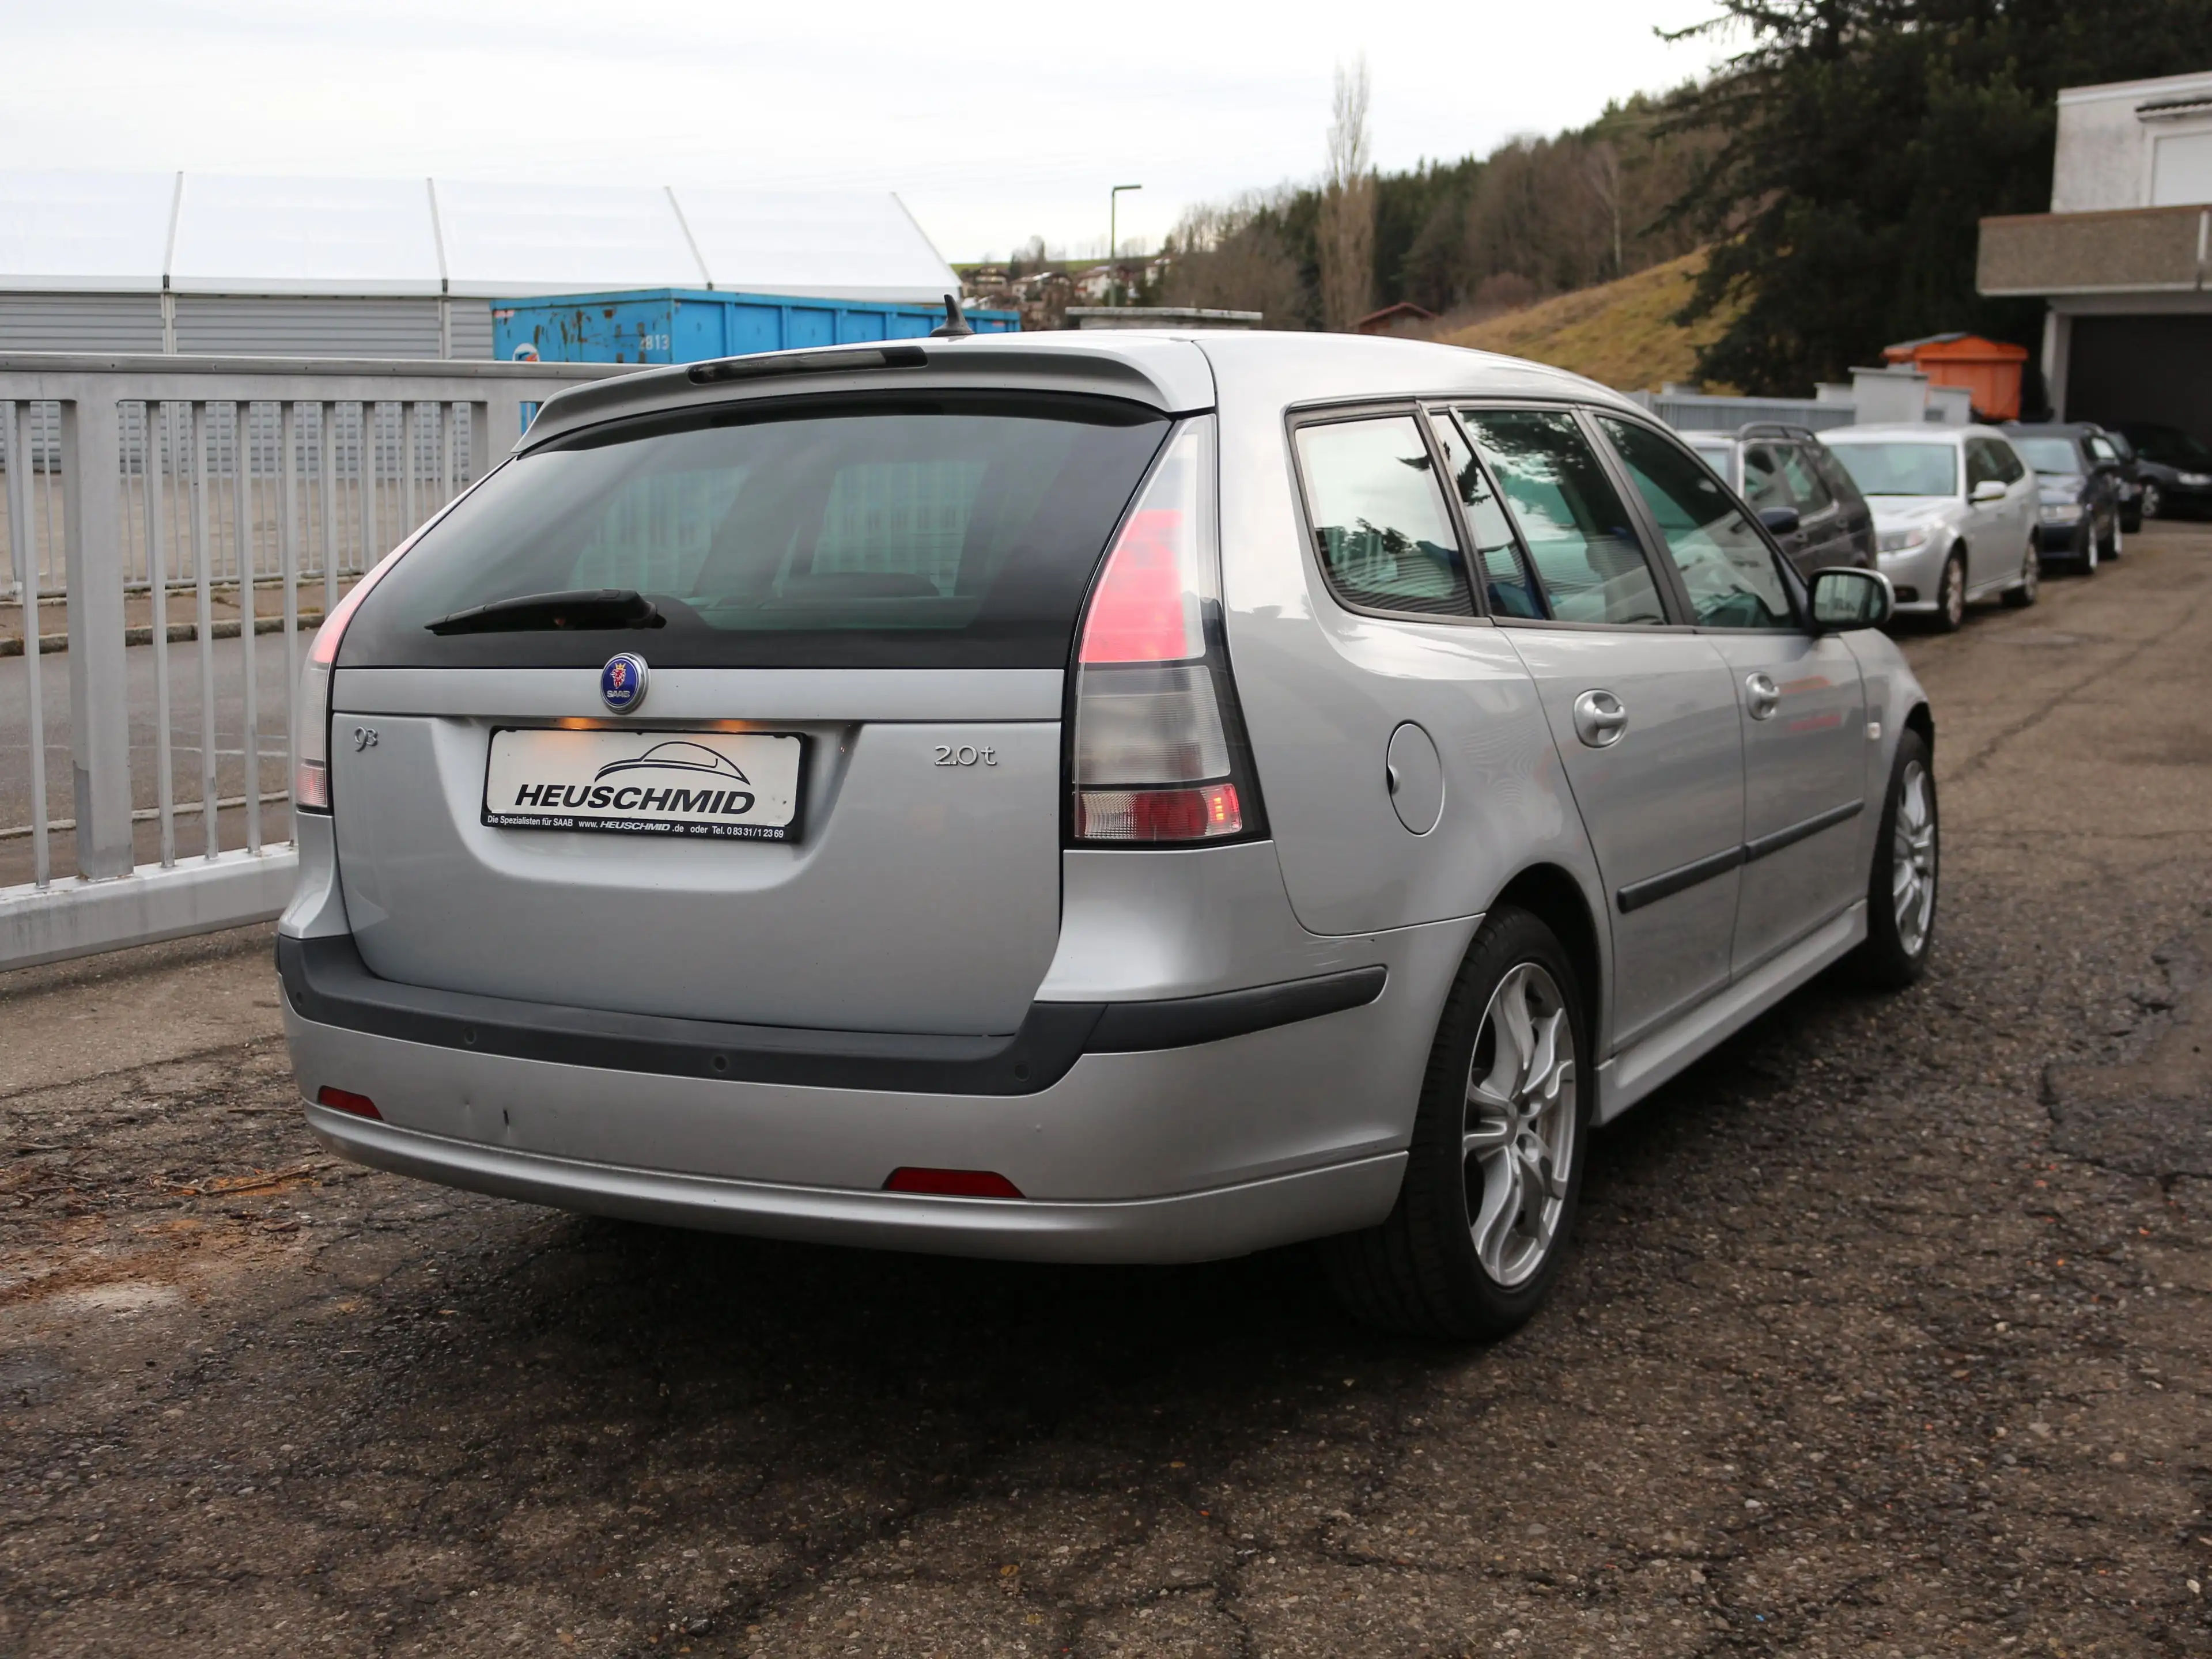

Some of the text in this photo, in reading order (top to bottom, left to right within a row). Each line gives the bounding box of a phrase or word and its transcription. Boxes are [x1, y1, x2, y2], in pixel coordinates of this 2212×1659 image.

[607, 690, 630, 698] SAAB
[935, 745, 997, 766] 2.0t
[515, 784, 755, 815] HEUSCHMID
[487, 815, 499, 824] Die
[500, 816, 540, 825] Spezialisten
[542, 818, 552, 826] für
[553, 818, 573, 827] SAAB
[600, 821, 671, 831] HEUSCHMID
[672, 824, 685, 832] .de
[690, 825, 708, 833] oder
[712, 825, 725, 835] Tel.
